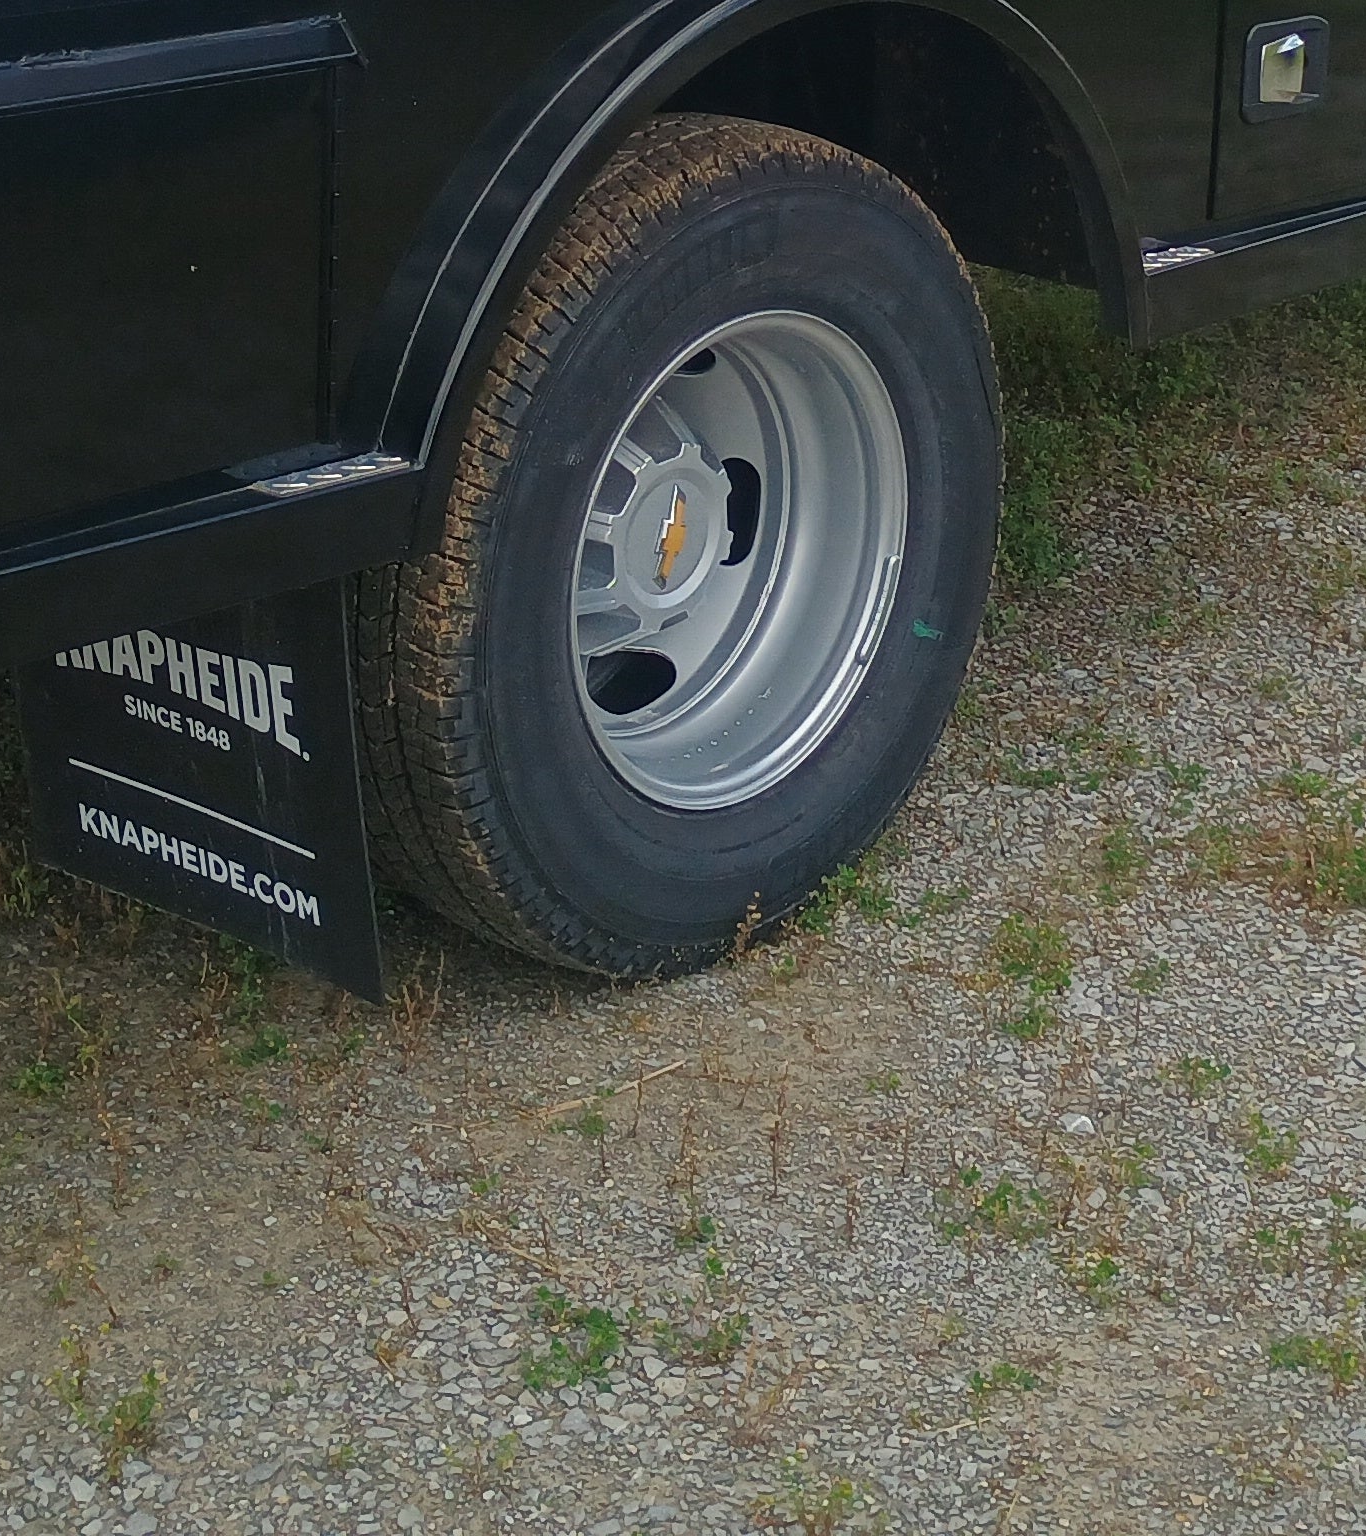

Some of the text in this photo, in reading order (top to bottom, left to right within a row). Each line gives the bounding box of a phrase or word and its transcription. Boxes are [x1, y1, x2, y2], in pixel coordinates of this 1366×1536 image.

[123, 694, 232, 751] SINCE 1848
[78, 802, 322, 927] KNAPHEIDE.COM
